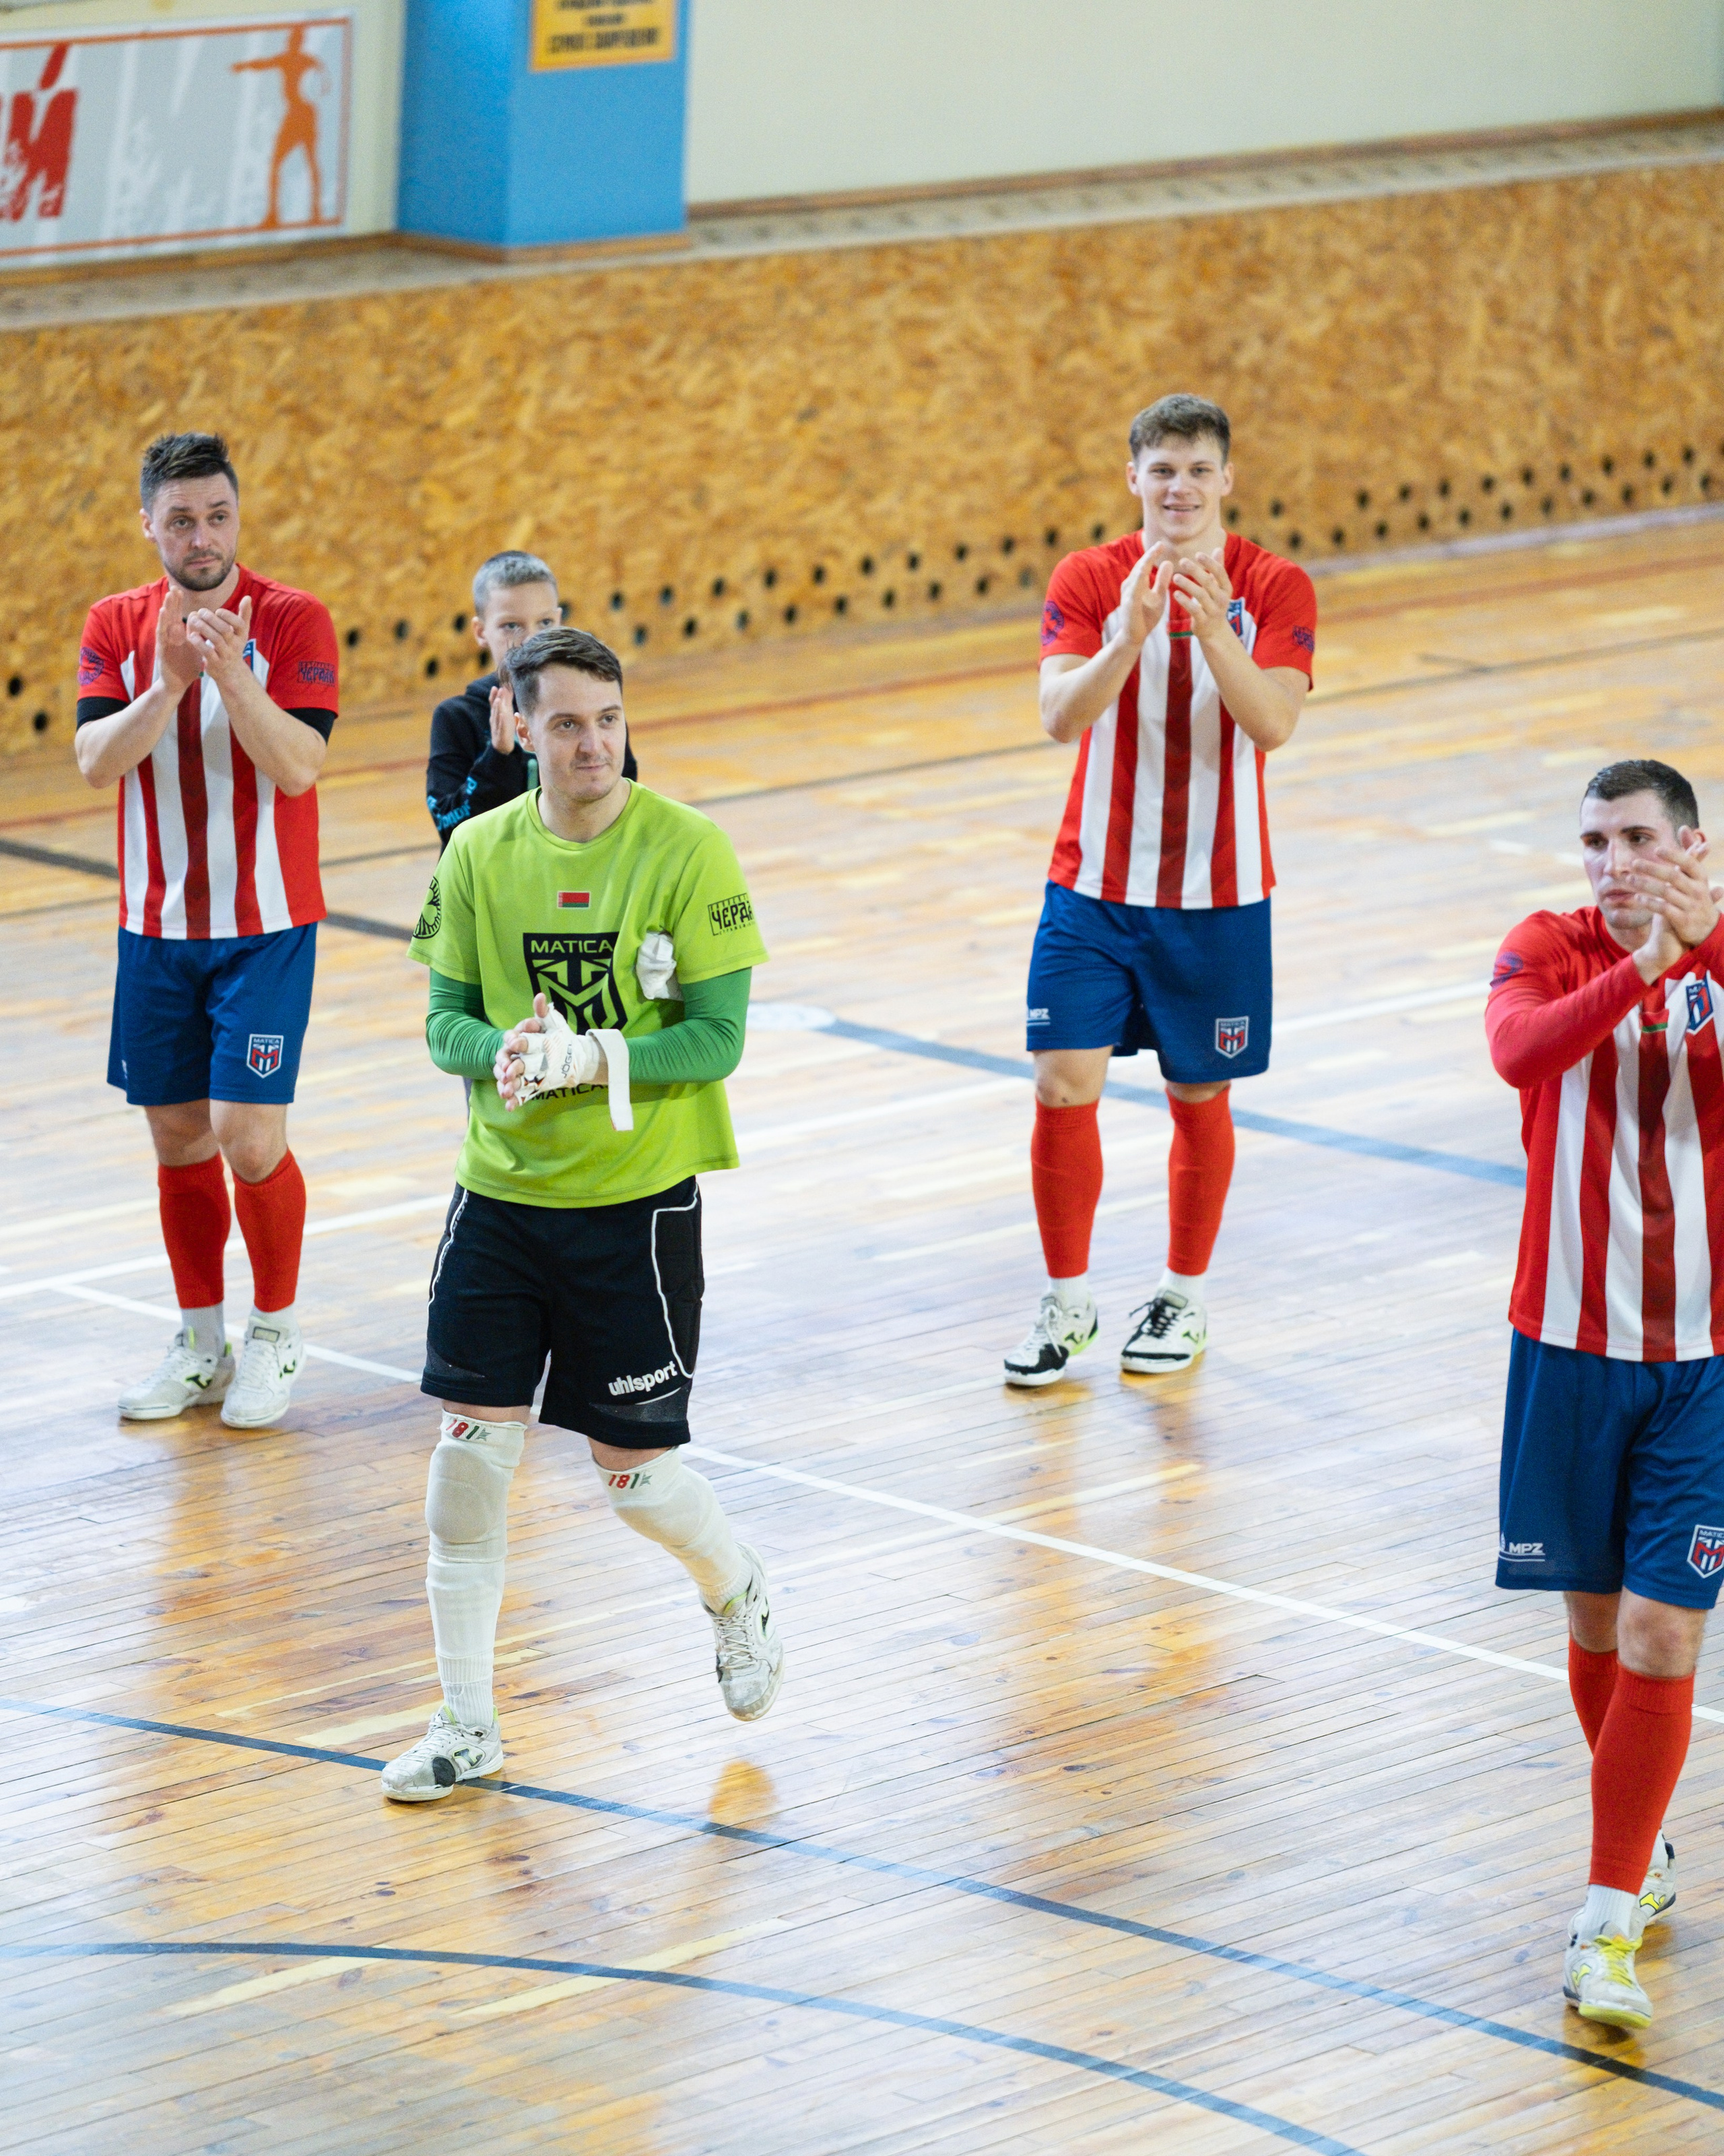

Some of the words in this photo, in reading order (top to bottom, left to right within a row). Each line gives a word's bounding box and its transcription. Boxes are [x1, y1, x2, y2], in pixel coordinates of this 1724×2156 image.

[0, 42, 78, 222] Й
[531, 939, 614, 954] MATICA
[608, 1361, 677, 1396] uhlsport
[1508, 1542, 1544, 1555] MPZ
